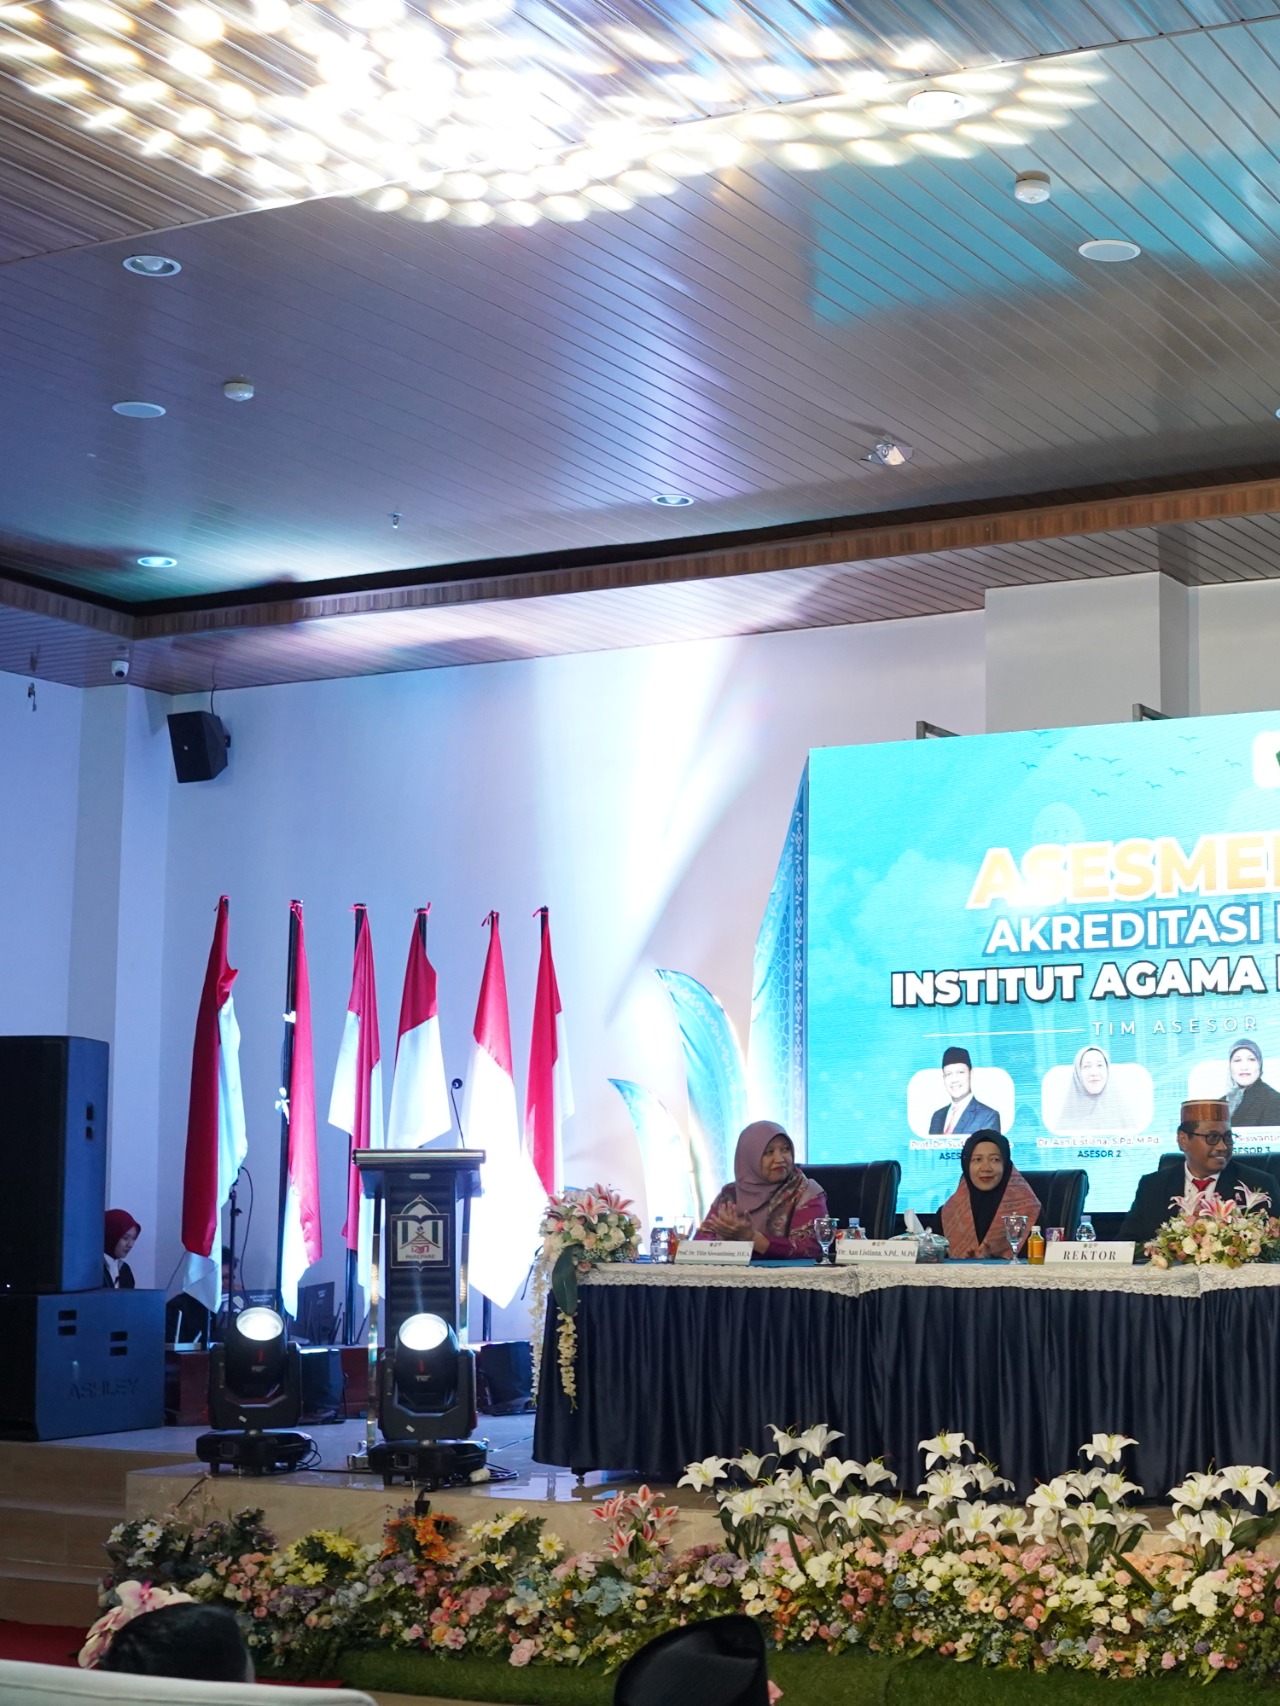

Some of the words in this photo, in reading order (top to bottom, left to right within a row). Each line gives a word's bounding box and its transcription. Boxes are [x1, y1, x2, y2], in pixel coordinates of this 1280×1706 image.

[984, 902, 1263, 956] AKREDITASI
[891, 963, 1084, 1006] INSTITUT
[1090, 955, 1266, 999] AGAMA
[1092, 1020, 1136, 1036] TIM
[1153, 1015, 1258, 1034] ASESOR
[1077, 1150, 1114, 1158] ASESOR
[1115, 1149, 1122, 1158] 2
[1232, 1146, 1263, 1154] SESOR
[939, 1152, 962, 1160] ASES
[1063, 1250, 1116, 1261] REKTOR
